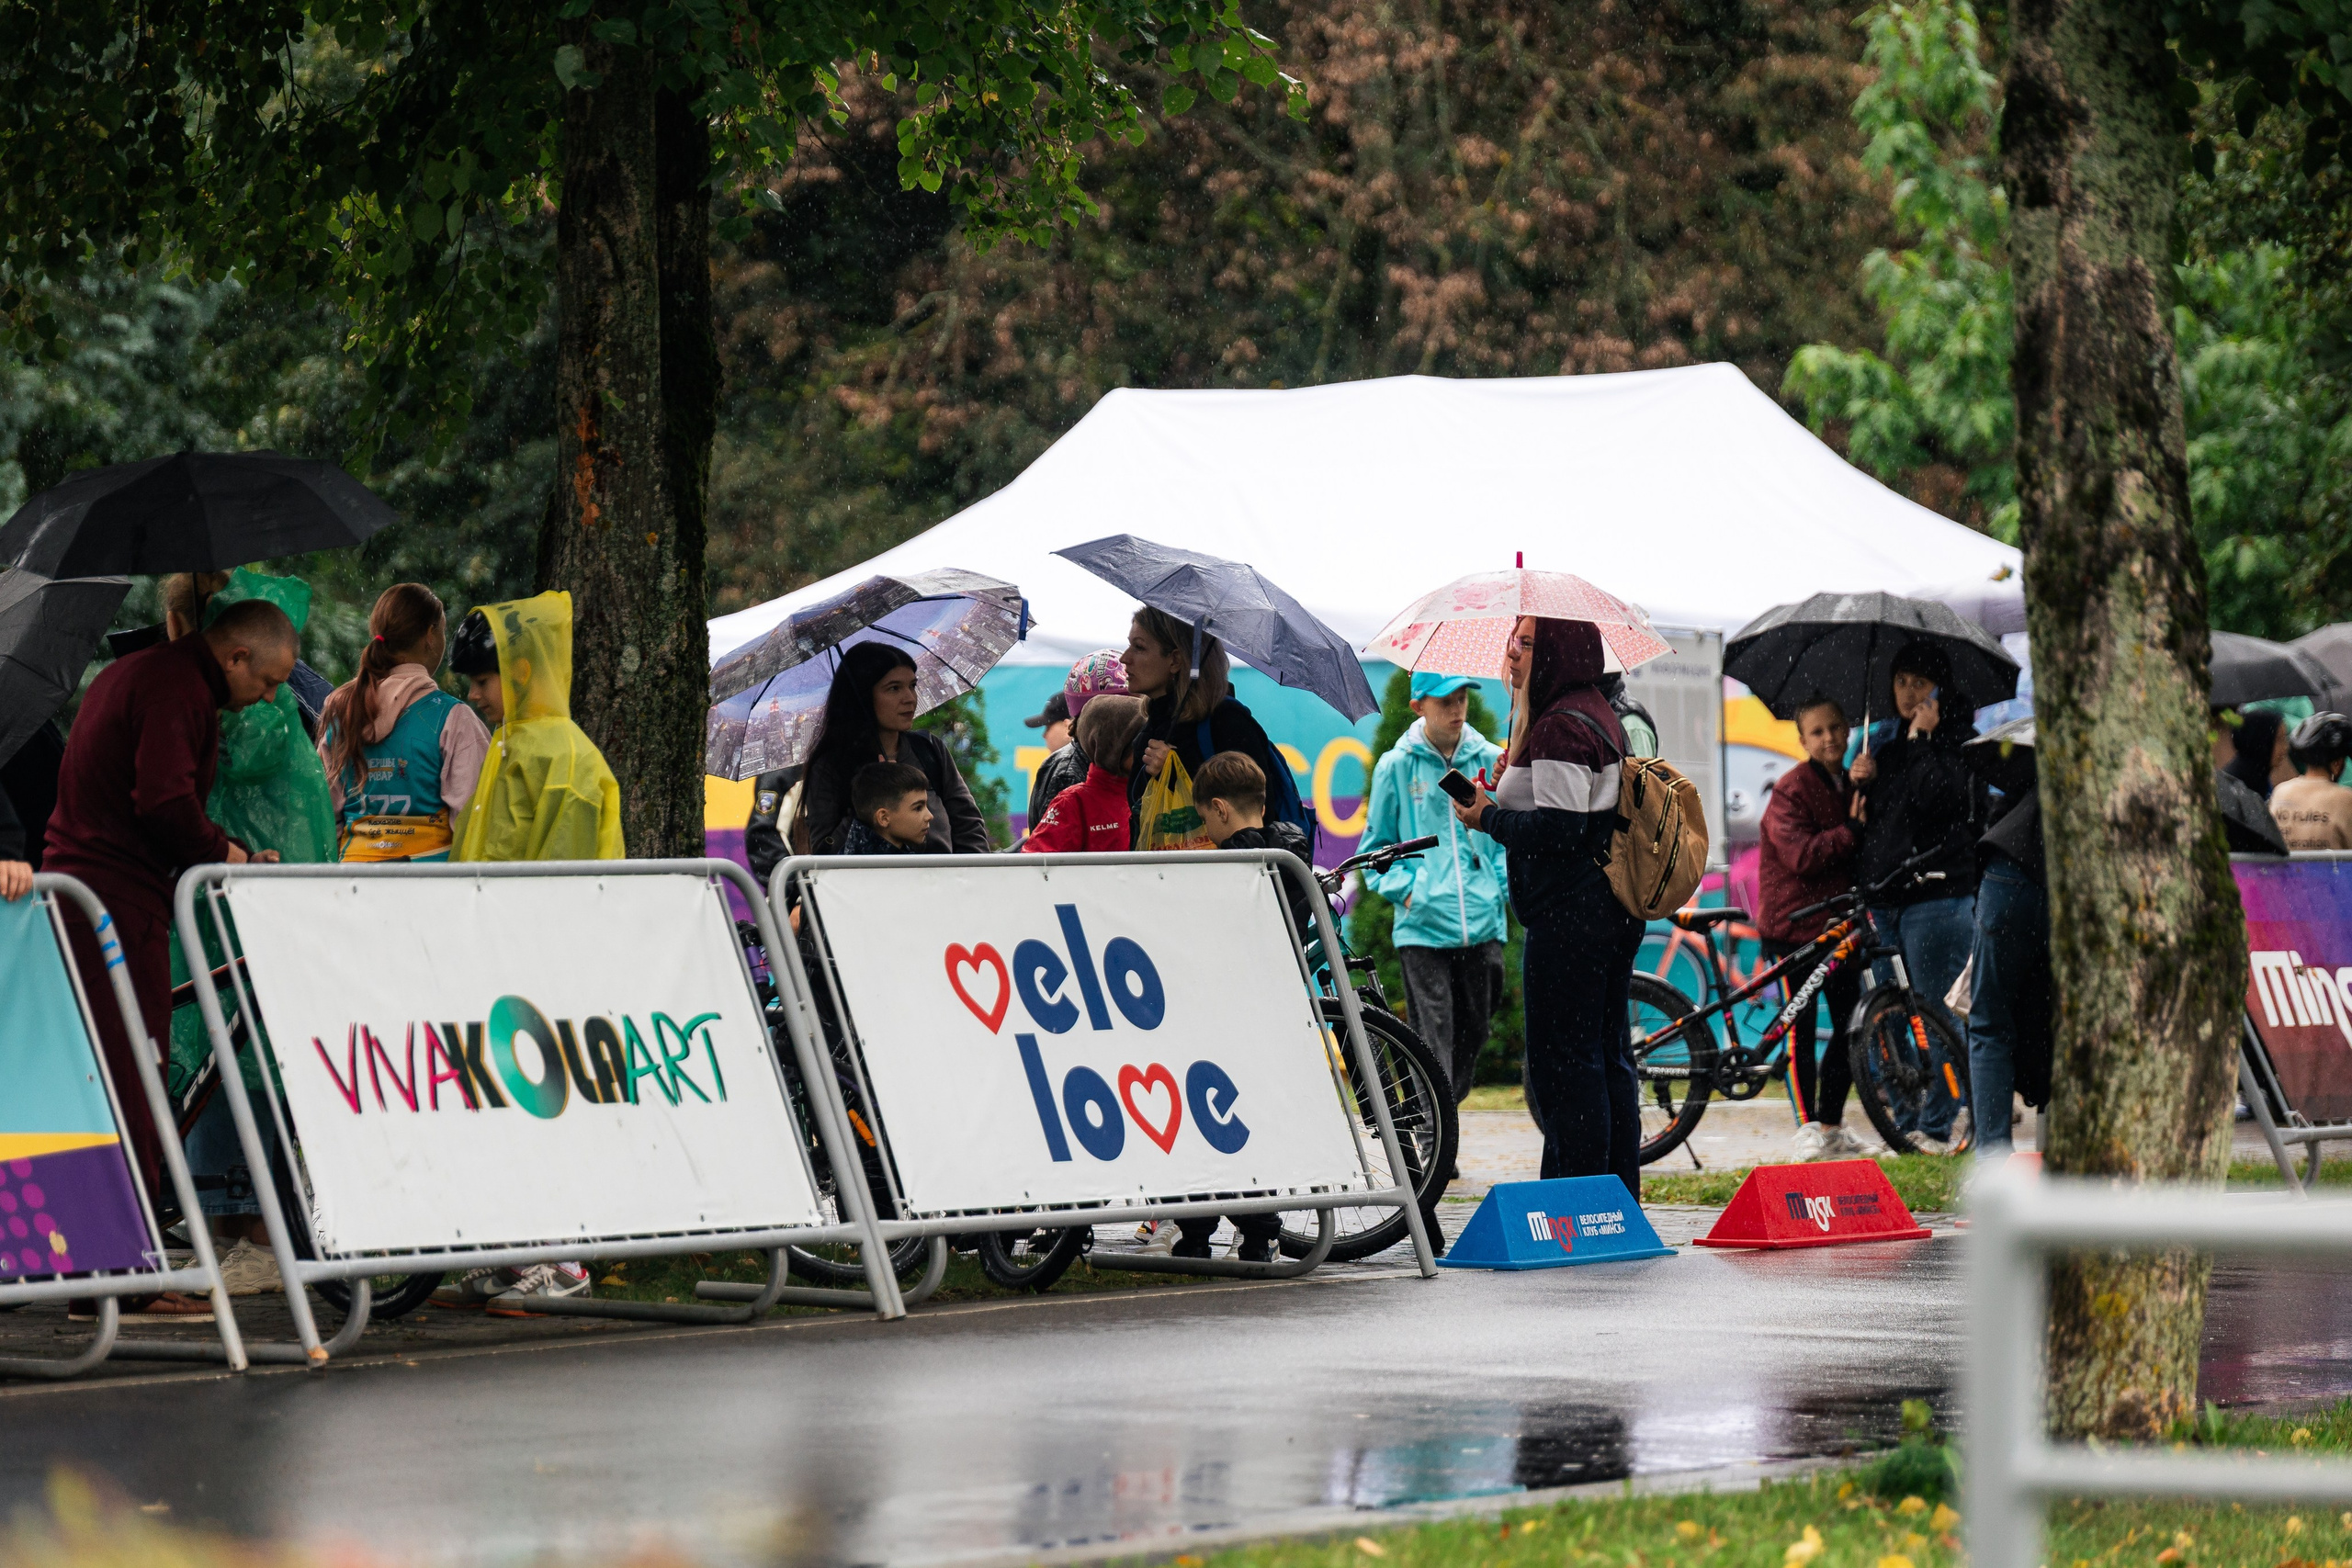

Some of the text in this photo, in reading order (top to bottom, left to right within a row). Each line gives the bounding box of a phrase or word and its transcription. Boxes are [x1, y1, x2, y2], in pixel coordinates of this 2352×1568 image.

[1090, 822, 1119, 831] KELME
[1780, 963, 1829, 1023] KRAKKEN
[1579, 1209, 1624, 1225] ВЕЛОСИПЕДНЫЙ
[1582, 1225, 1599, 1237] КЛУБ
